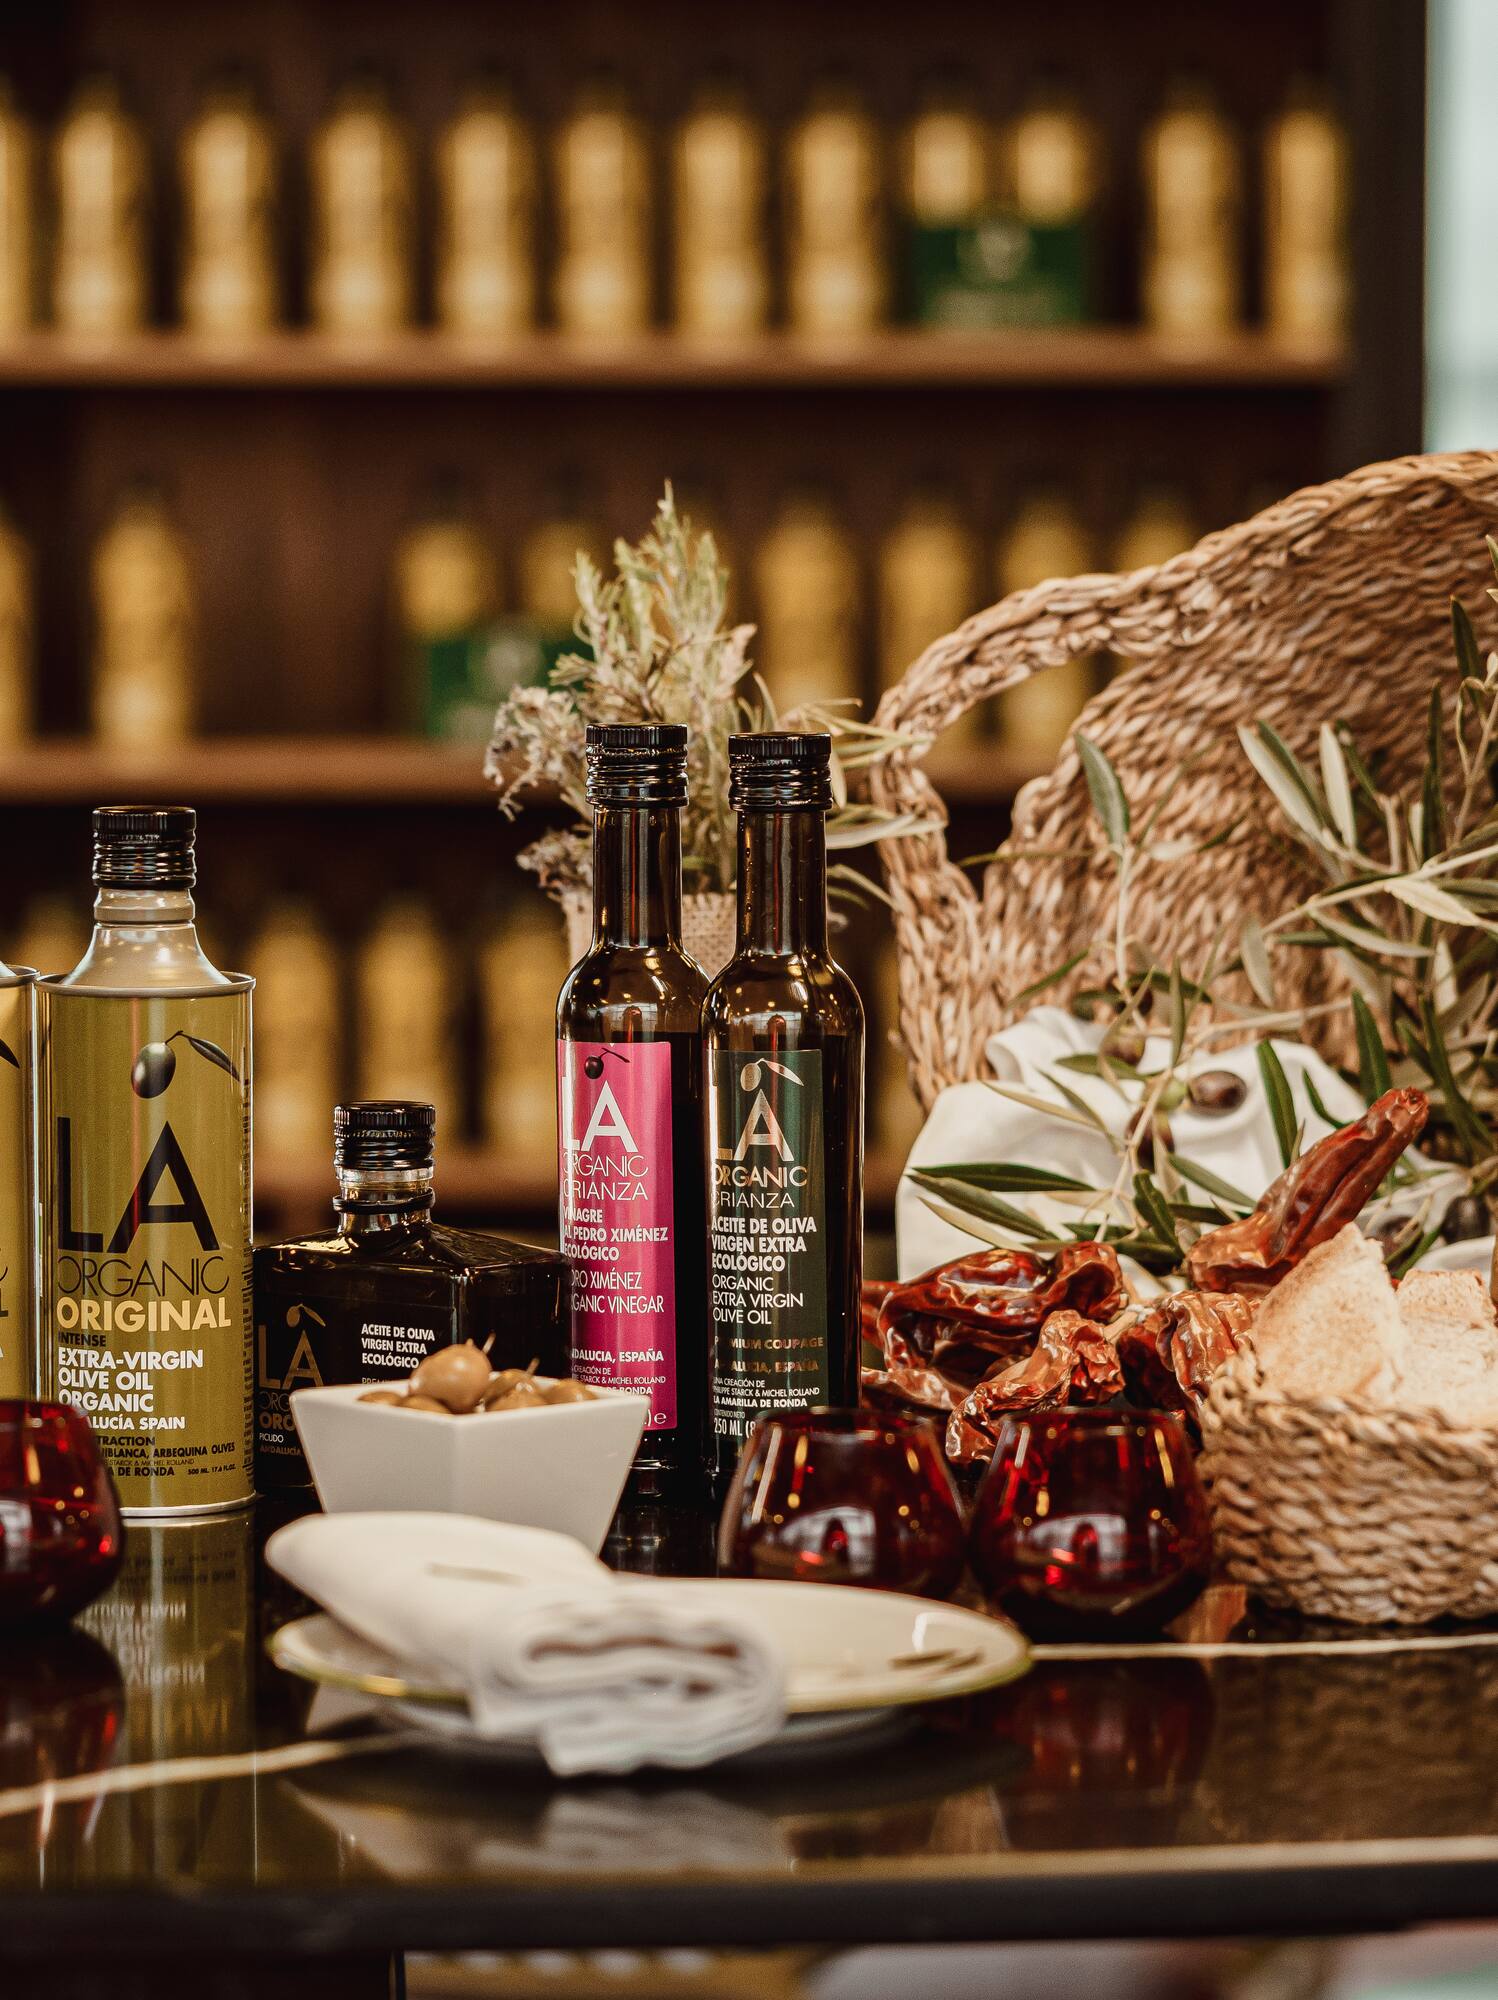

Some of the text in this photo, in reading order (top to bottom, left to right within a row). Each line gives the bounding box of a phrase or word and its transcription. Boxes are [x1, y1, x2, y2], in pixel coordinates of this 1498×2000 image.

[712, 1164, 808, 1188] ORGANIC
[711, 1191, 795, 1208] CRIANZA
[573, 1226, 607, 1242] PEDRO
[611, 1224, 668, 1242] XIMÉNEZ
[711, 1216, 817, 1234] ACEITE DE OLIVA
[564, 1243, 620, 1261] ECOLÓGICO
[712, 1234, 807, 1253] VIRGEN EXTRA
[712, 1250, 785, 1272] ECOLÓGICO
[58, 1256, 229, 1297] ORGANIC
[590, 1267, 642, 1289] XIMÉNEZ
[712, 1274, 774, 1291] ORGANIC
[572, 1293, 664, 1314] GANIC VINEGAR
[713, 1291, 803, 1308] EXTRA VIRGIN
[56, 1297, 231, 1332] ORIGINAL
[713, 1306, 772, 1325] OLIVE OIL
[58, 1331, 106, 1347] INTENSE
[361, 1323, 435, 1341] ACEITE DE OLIVA
[361, 1338, 427, 1355] VIRGEN EXTRA
[764, 1337, 824, 1350] COUPAGE
[58, 1347, 203, 1370] EXTRA-VIRGIN
[362, 1353, 419, 1369] ECOLÓGICO
[619, 1348, 664, 1362] ESPAÑA
[58, 1367, 153, 1391] OLIVE OIL
[603, 1367, 611, 1376] DE
[608, 1377, 633, 1385] MICHEL
[634, 1376, 666, 1384] ROLLAND
[724, 1378, 754, 1388] CREACIÓN
[756, 1380, 765, 1388] DE
[58, 1389, 153, 1412] ORGANIC
[731, 1388, 753, 1397] STARCK
[755, 1389, 760, 1397] &
[762, 1388, 787, 1397] MICHEL
[789, 1387, 820, 1397] ROLLAND
[721, 1397, 758, 1407] AMARILLA
[760, 1399, 771, 1408] DE
[774, 1398, 808, 1407] RONDA
[140, 1416, 185, 1430] SPAIN
[714, 1418, 726, 1434] 250
[729, 1419, 742, 1437] ML
[97, 1436, 155, 1447] TRACTION
[259, 1432, 284, 1443] PICUDO
[154, 1446, 207, 1458] ARBEQUINA
[212, 1442, 235, 1455] OLIVES
[118, 1467, 132, 1477] DE
[135, 1467, 175, 1477] RONDA
